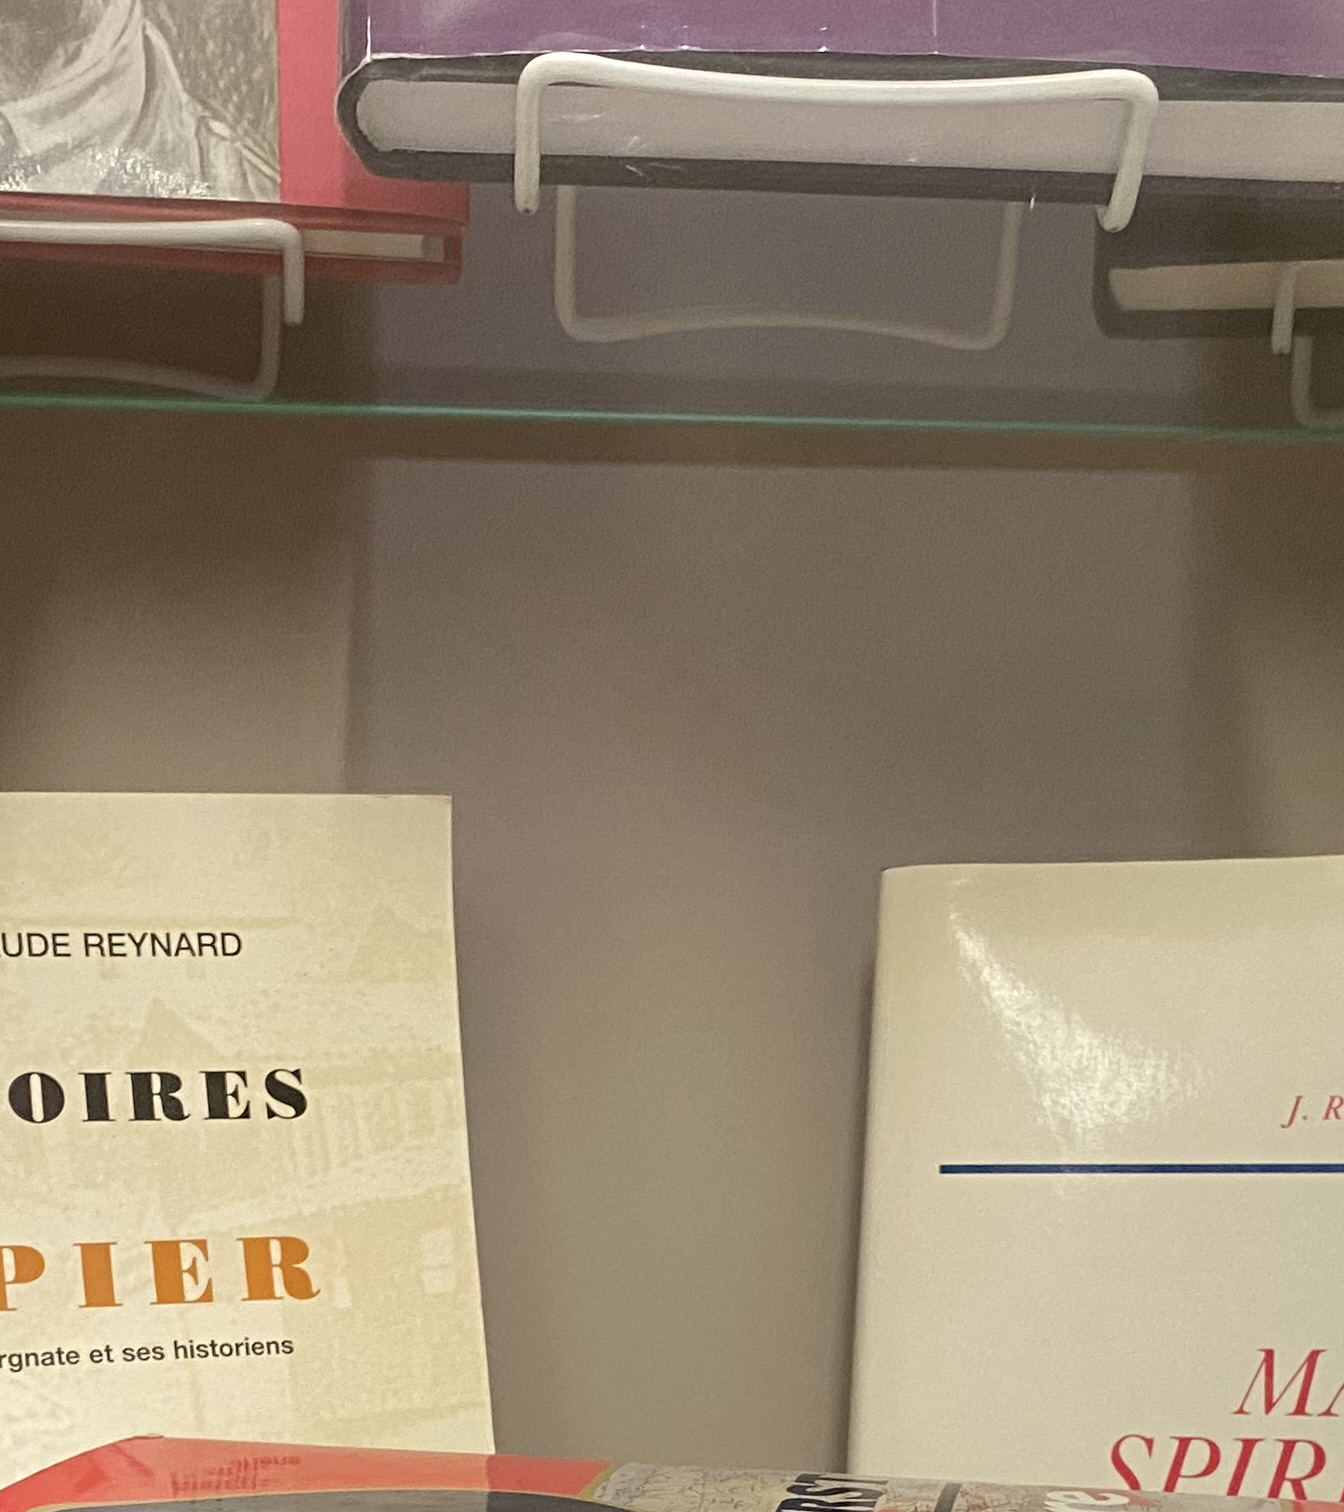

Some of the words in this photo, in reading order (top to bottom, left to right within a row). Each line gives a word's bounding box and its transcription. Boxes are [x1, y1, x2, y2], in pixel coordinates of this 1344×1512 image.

[83, 932, 242, 958] REYNARD
[1281, 1095, 1308, 1129] J.
[89, 1344, 114, 1365] et
[121, 1343, 165, 1362] ses
[172, 1336, 294, 1360] historiens
